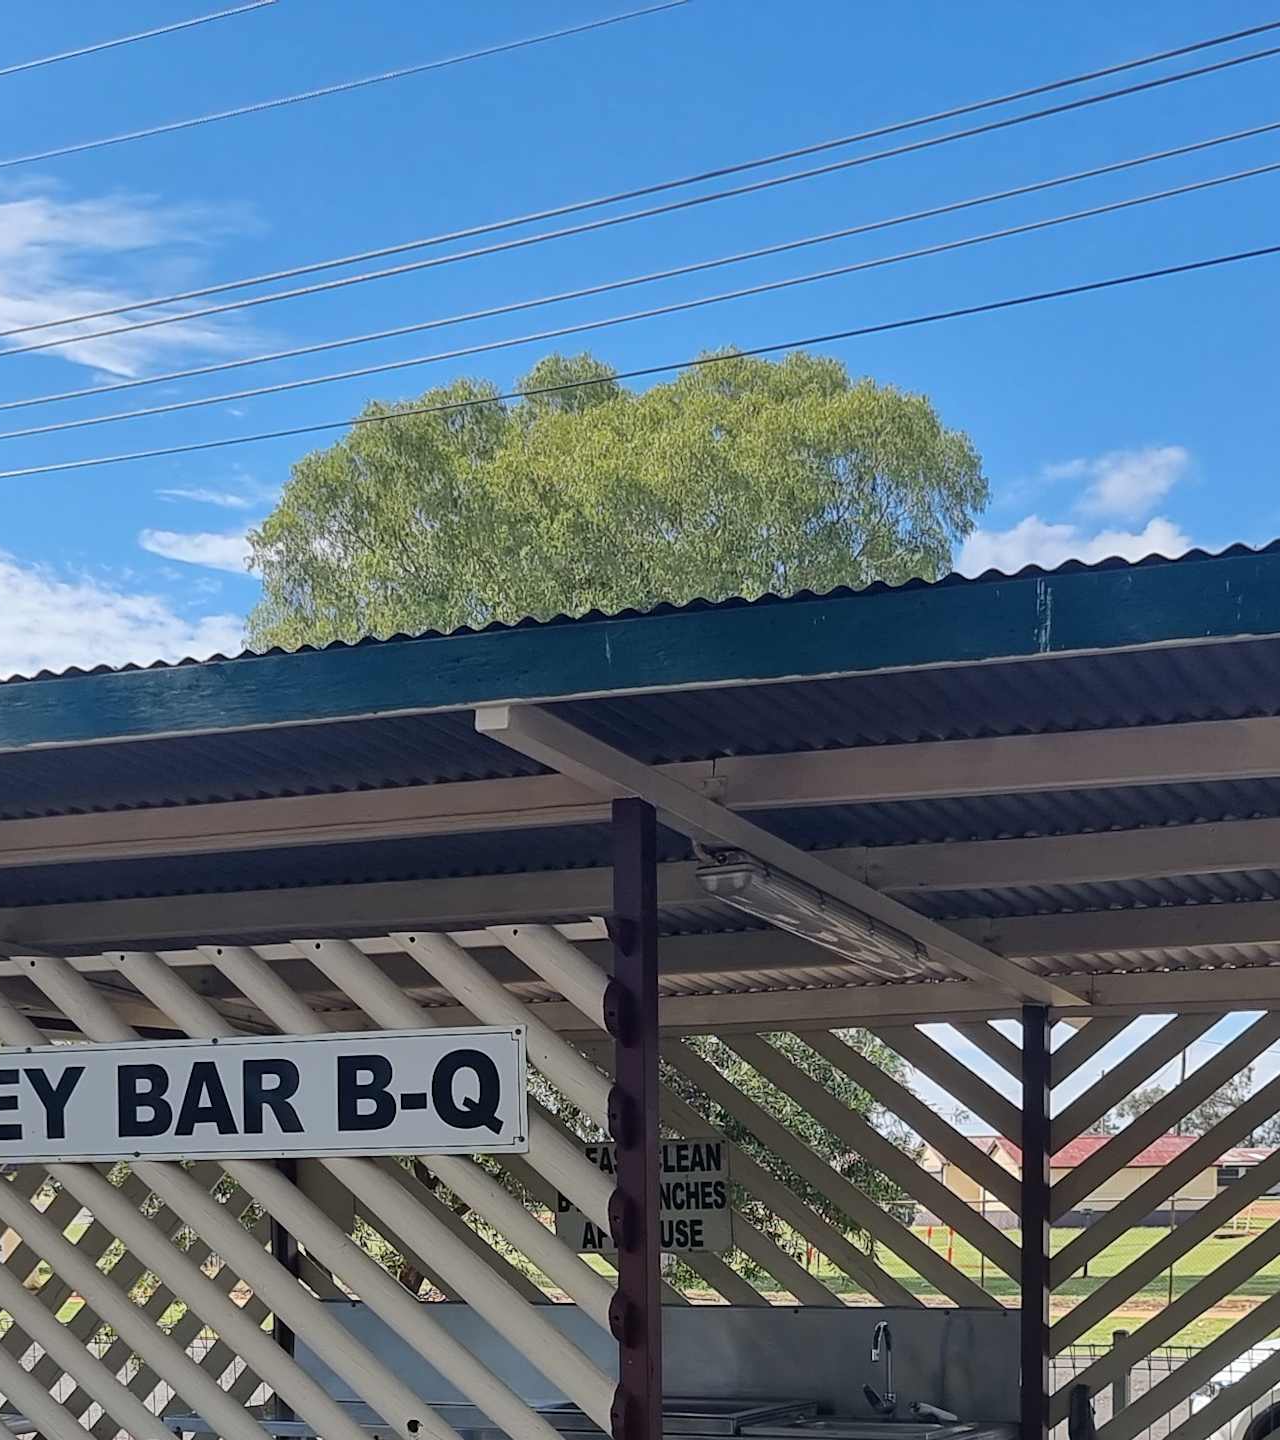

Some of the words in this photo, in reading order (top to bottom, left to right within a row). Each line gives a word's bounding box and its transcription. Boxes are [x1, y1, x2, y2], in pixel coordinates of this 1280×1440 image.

[117, 1057, 305, 1138] BAR
[337, 1048, 505, 1136] B-Q
[659, 1142, 722, 1173] LEAN
[659, 1180, 728, 1211] NCHES
[660, 1219, 704, 1249] USE
